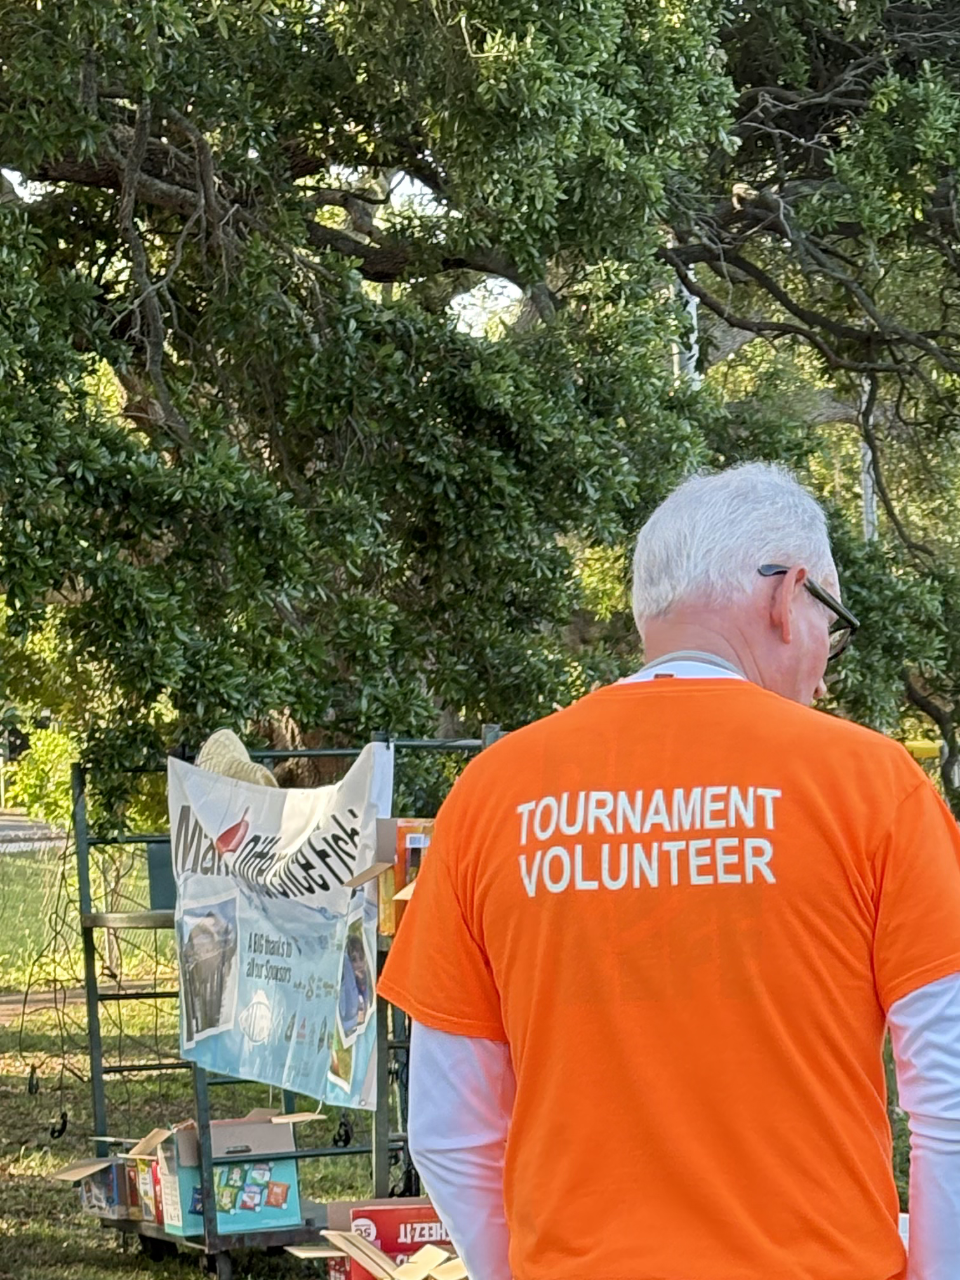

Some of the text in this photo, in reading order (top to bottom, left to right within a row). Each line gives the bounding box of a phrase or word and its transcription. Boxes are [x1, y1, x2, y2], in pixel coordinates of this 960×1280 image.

[516, 786, 782, 846] TOURNAMENT
[518, 837, 777, 897] VOLUNTEER
[253, 932, 265, 955] BIG
[264, 934, 285, 958] thanks
[246, 956, 292, 986] all our Sponsors
